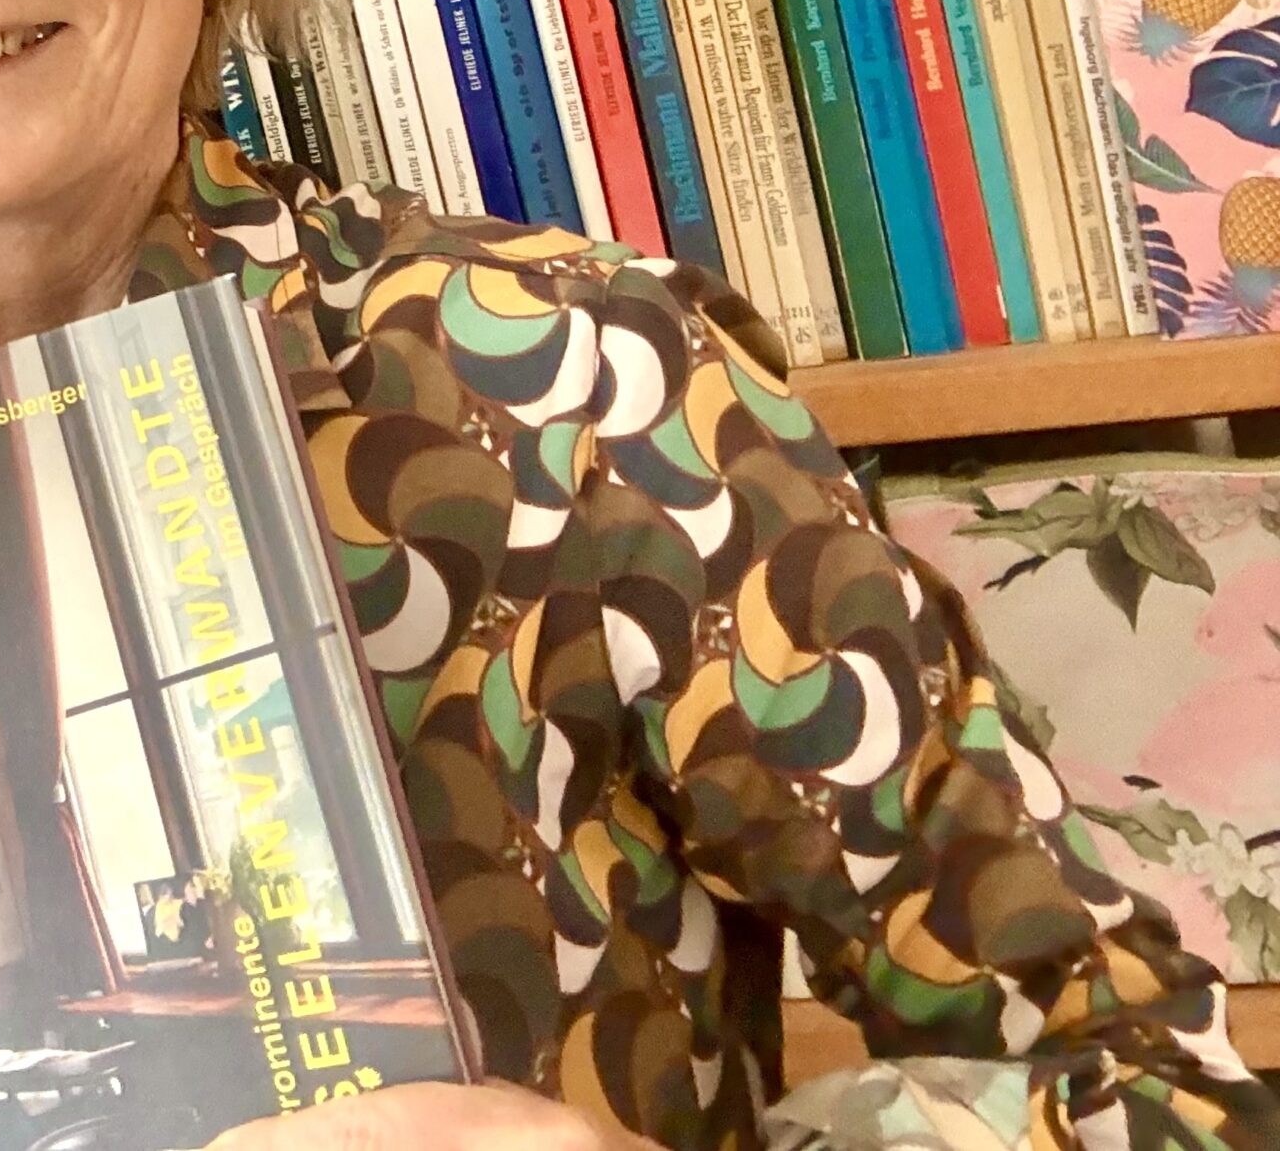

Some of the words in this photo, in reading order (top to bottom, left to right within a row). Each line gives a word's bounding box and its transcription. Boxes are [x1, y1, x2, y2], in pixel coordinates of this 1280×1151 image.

[698, 14, 715, 40] Wir
[724, 0, 744, 23] Der
[754, 6, 770, 32] Vor
[552, 35, 564, 51] Die
[759, 33, 776, 60] den
[915, 26, 941, 90] Bernhard
[1047, 42, 1068, 78] Land
[461, 47, 481, 91] ELFRIEDE
[703, 42, 726, 94] müssen
[810, 38, 836, 102] Bernhard
[566, 98, 585, 142] ELFRIEDE
[715, 96, 734, 137] wahre
[774, 105, 791, 128] der
[302, 121, 321, 164] ELFRIEDE
[360, 138, 379, 180] ELFRIEDE
[443, 126, 468, 199] Ausgesperrten
[651, 90, 702, 225] Bachmann
[724, 139, 743, 176] Sätze
[1076, 15, 1099, 75] Ingeborg
[1105, 151, 1120, 176] Das
[1123, 245, 1139, 274] Jahr
[460, 200, 473, 218] Die
[732, 177, 754, 223] finden
[170, 353, 232, 508] Gespräch
[234, 915, 302, 1117] rominente
